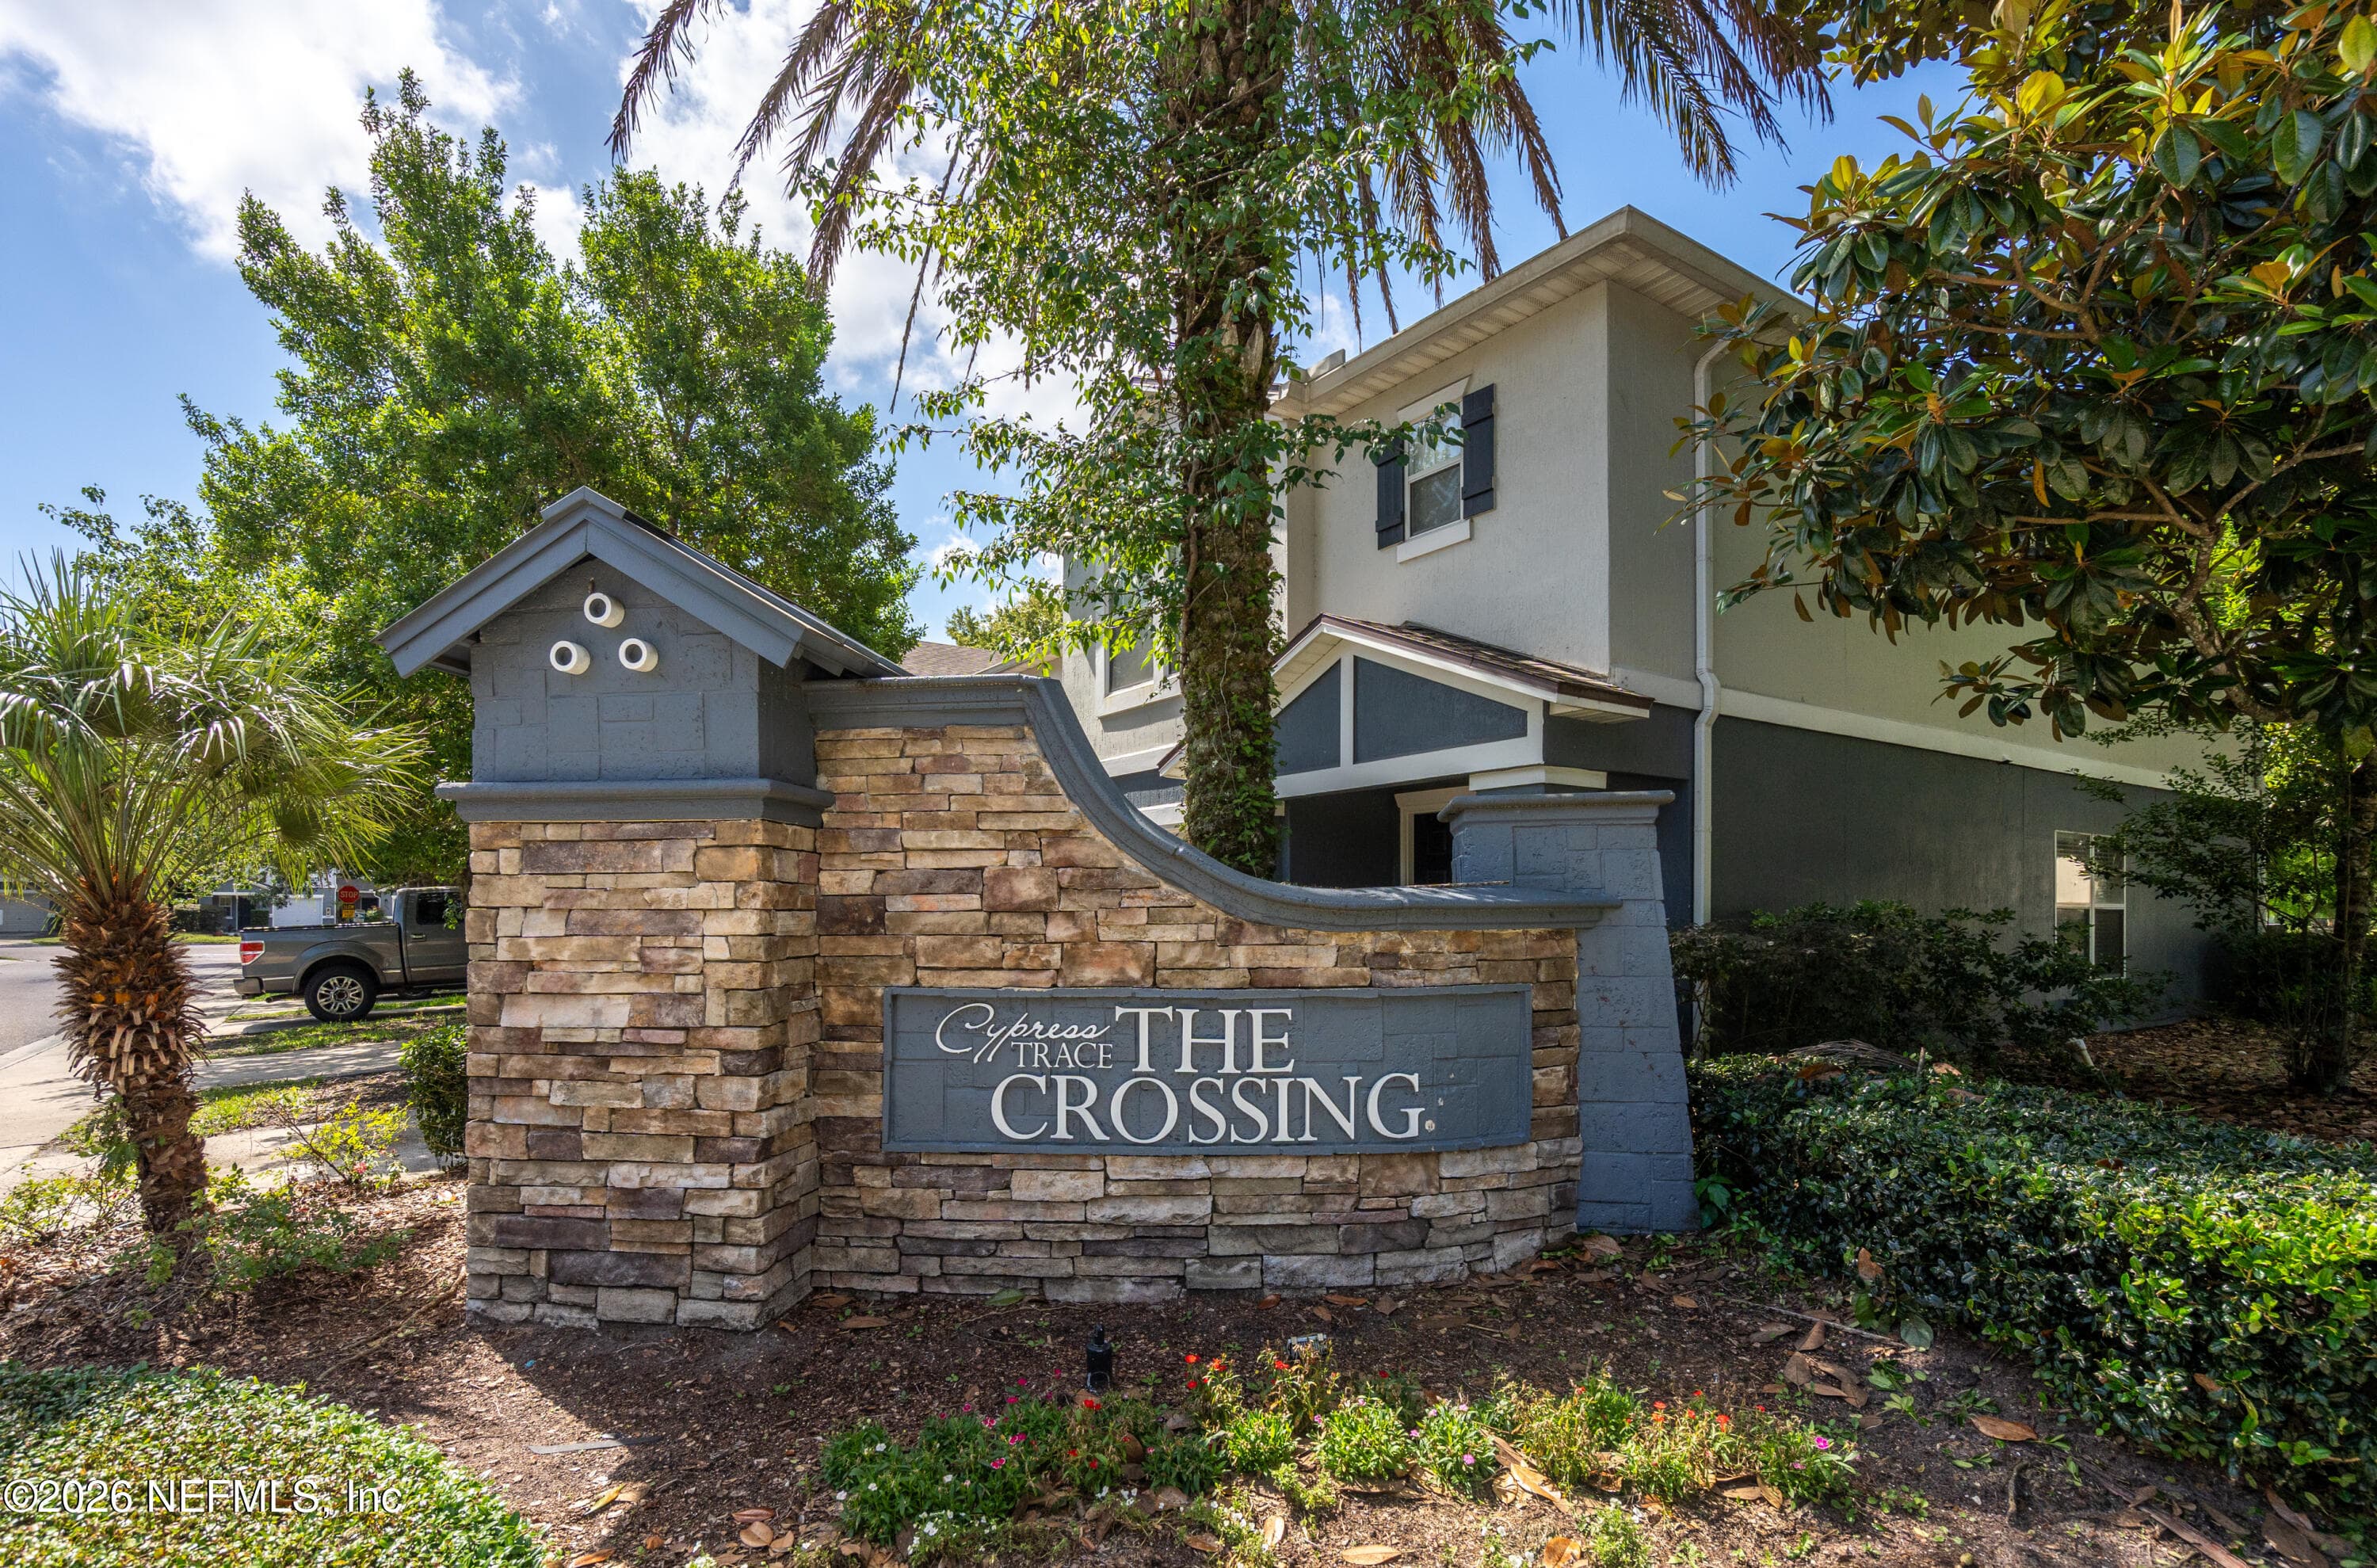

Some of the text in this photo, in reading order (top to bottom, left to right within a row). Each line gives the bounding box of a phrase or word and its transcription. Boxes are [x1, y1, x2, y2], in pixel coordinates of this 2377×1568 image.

[936, 1003, 1109, 1063] Cypress
[1011, 1041, 1112, 1069] TRACE
[1115, 1005, 1295, 1074] THE
[990, 1073, 1426, 1143] CROSSING
